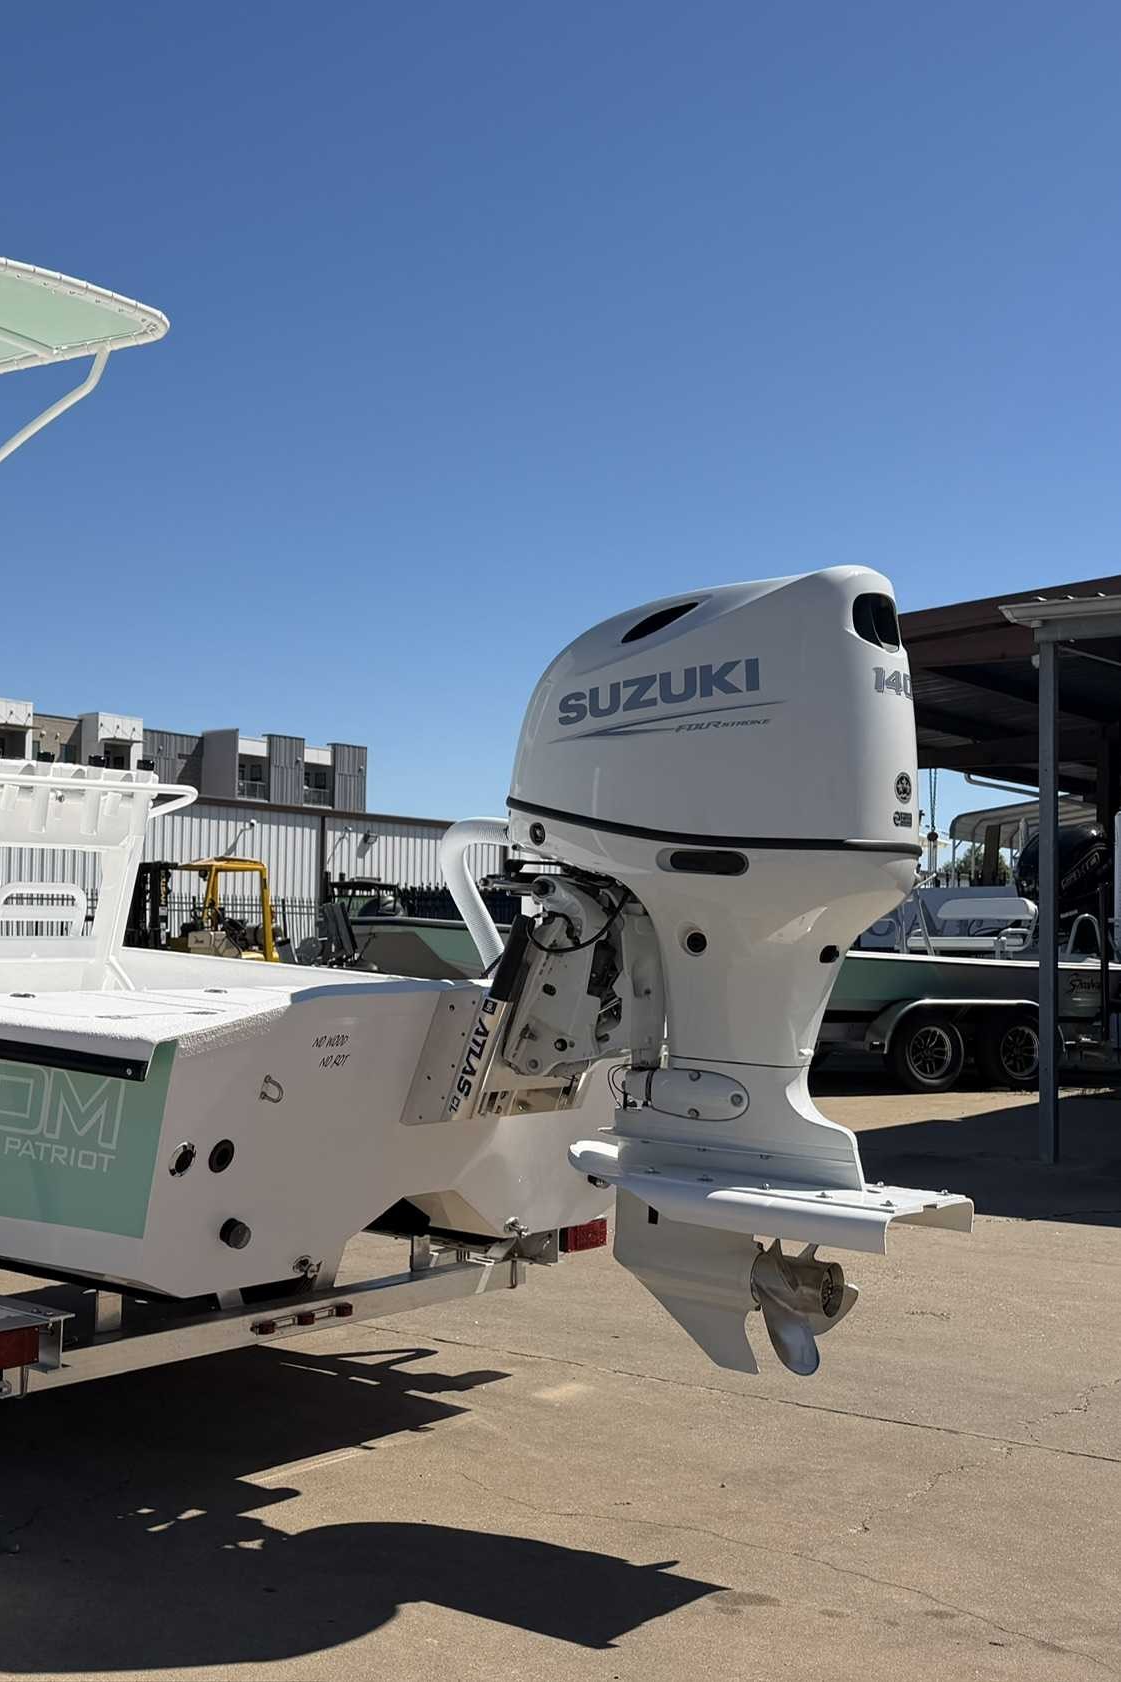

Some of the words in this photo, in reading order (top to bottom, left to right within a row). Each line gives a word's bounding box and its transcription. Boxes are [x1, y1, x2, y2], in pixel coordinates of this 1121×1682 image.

[558, 657, 760, 726] SUZUKI
[312, 1035, 327, 1048] NO
[326, 1033, 349, 1048] WOOD
[457, 1016, 490, 1097] ATLAS
[319, 1055, 333, 1068] NO
[331, 1054, 350, 1069] ROT
[4, 1136, 116, 1173] PATRIOT
